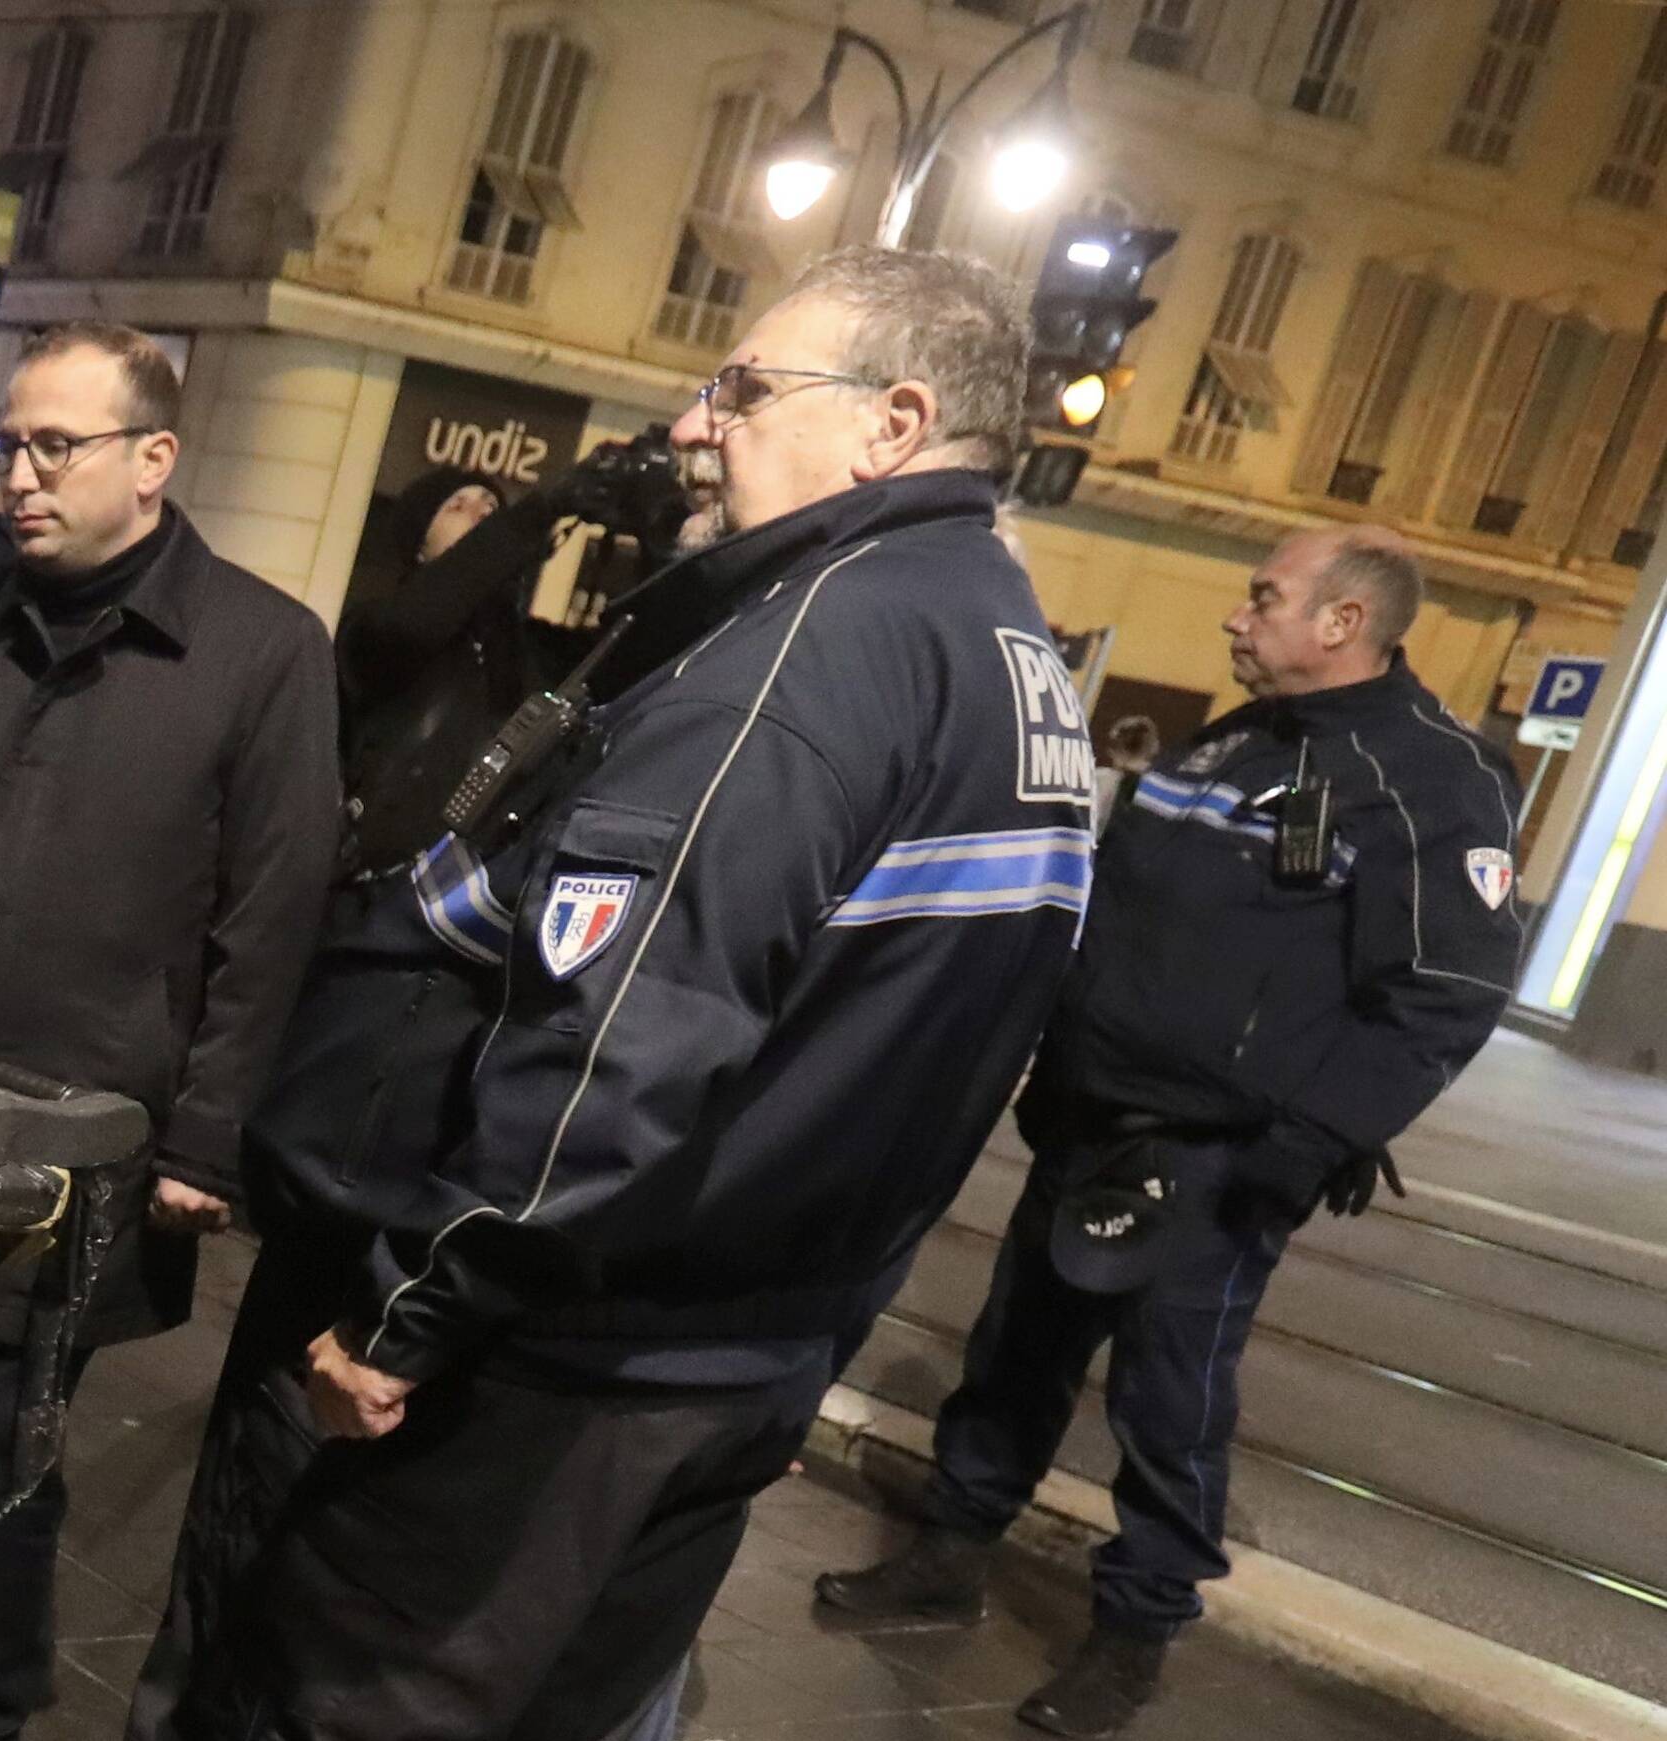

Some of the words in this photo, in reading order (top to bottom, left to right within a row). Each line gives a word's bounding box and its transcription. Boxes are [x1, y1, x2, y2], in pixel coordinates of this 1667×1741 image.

[427, 417, 548, 482] undiz
[1546, 669, 1584, 709] P
[560, 881, 628, 896] POLICE
